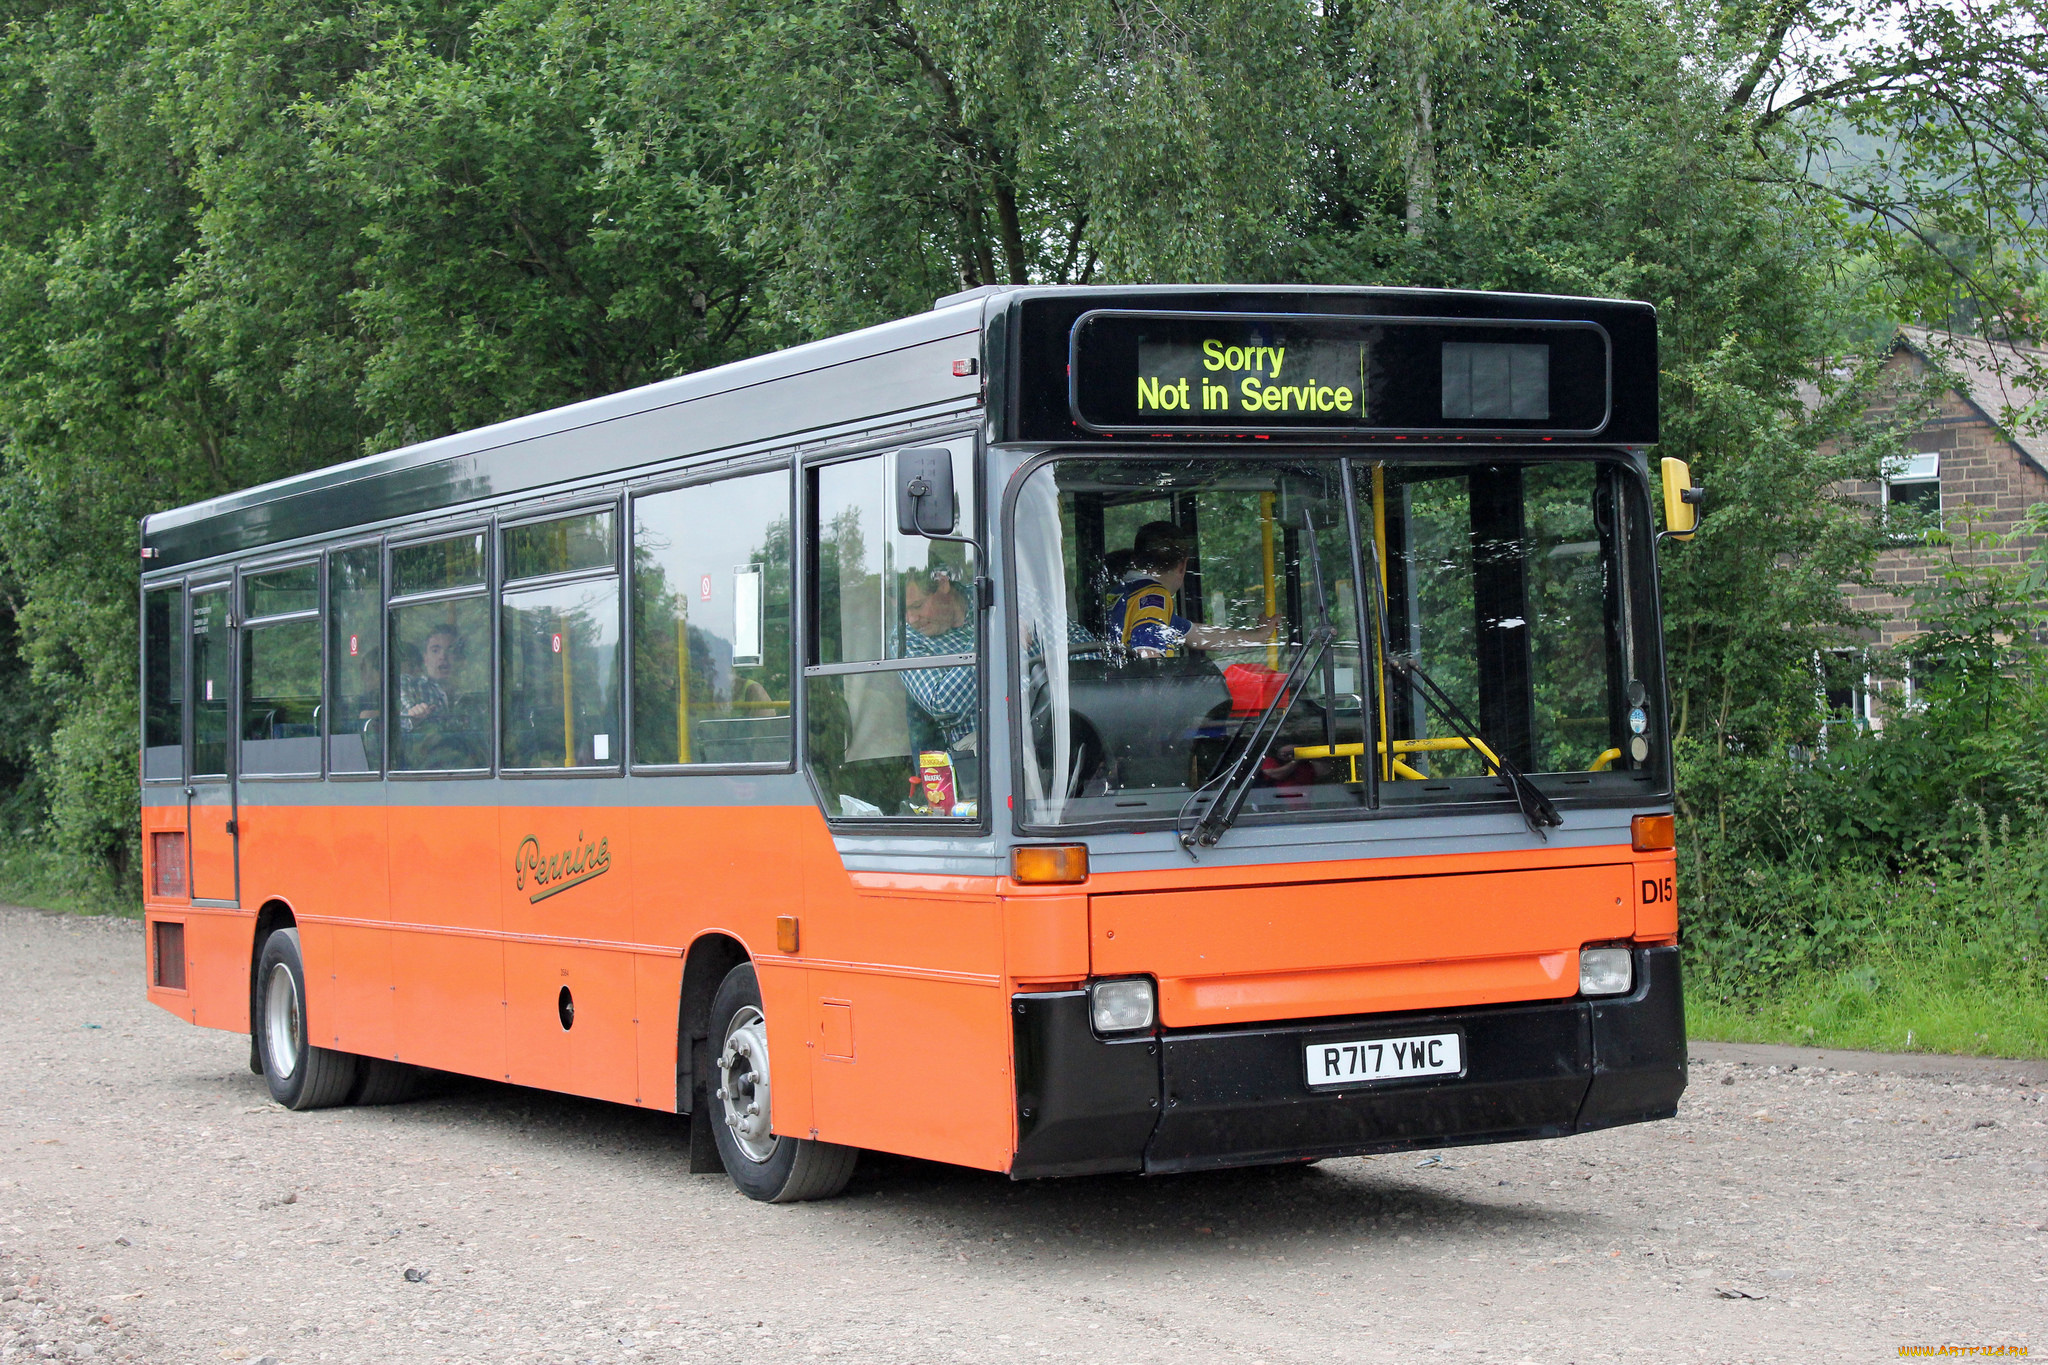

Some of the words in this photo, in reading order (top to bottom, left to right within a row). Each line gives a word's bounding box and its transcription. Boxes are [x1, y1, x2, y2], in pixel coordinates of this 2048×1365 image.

[1203, 339, 1285, 378] Sorry
[1137, 377, 1190, 410] Not
[1203, 377, 1229, 410] in
[1240, 377, 1353, 412] Service
[516, 829, 611, 898] Pennine
[1324, 1044, 1384, 1076] R717
[1392, 1039, 1444, 1070] YWC
